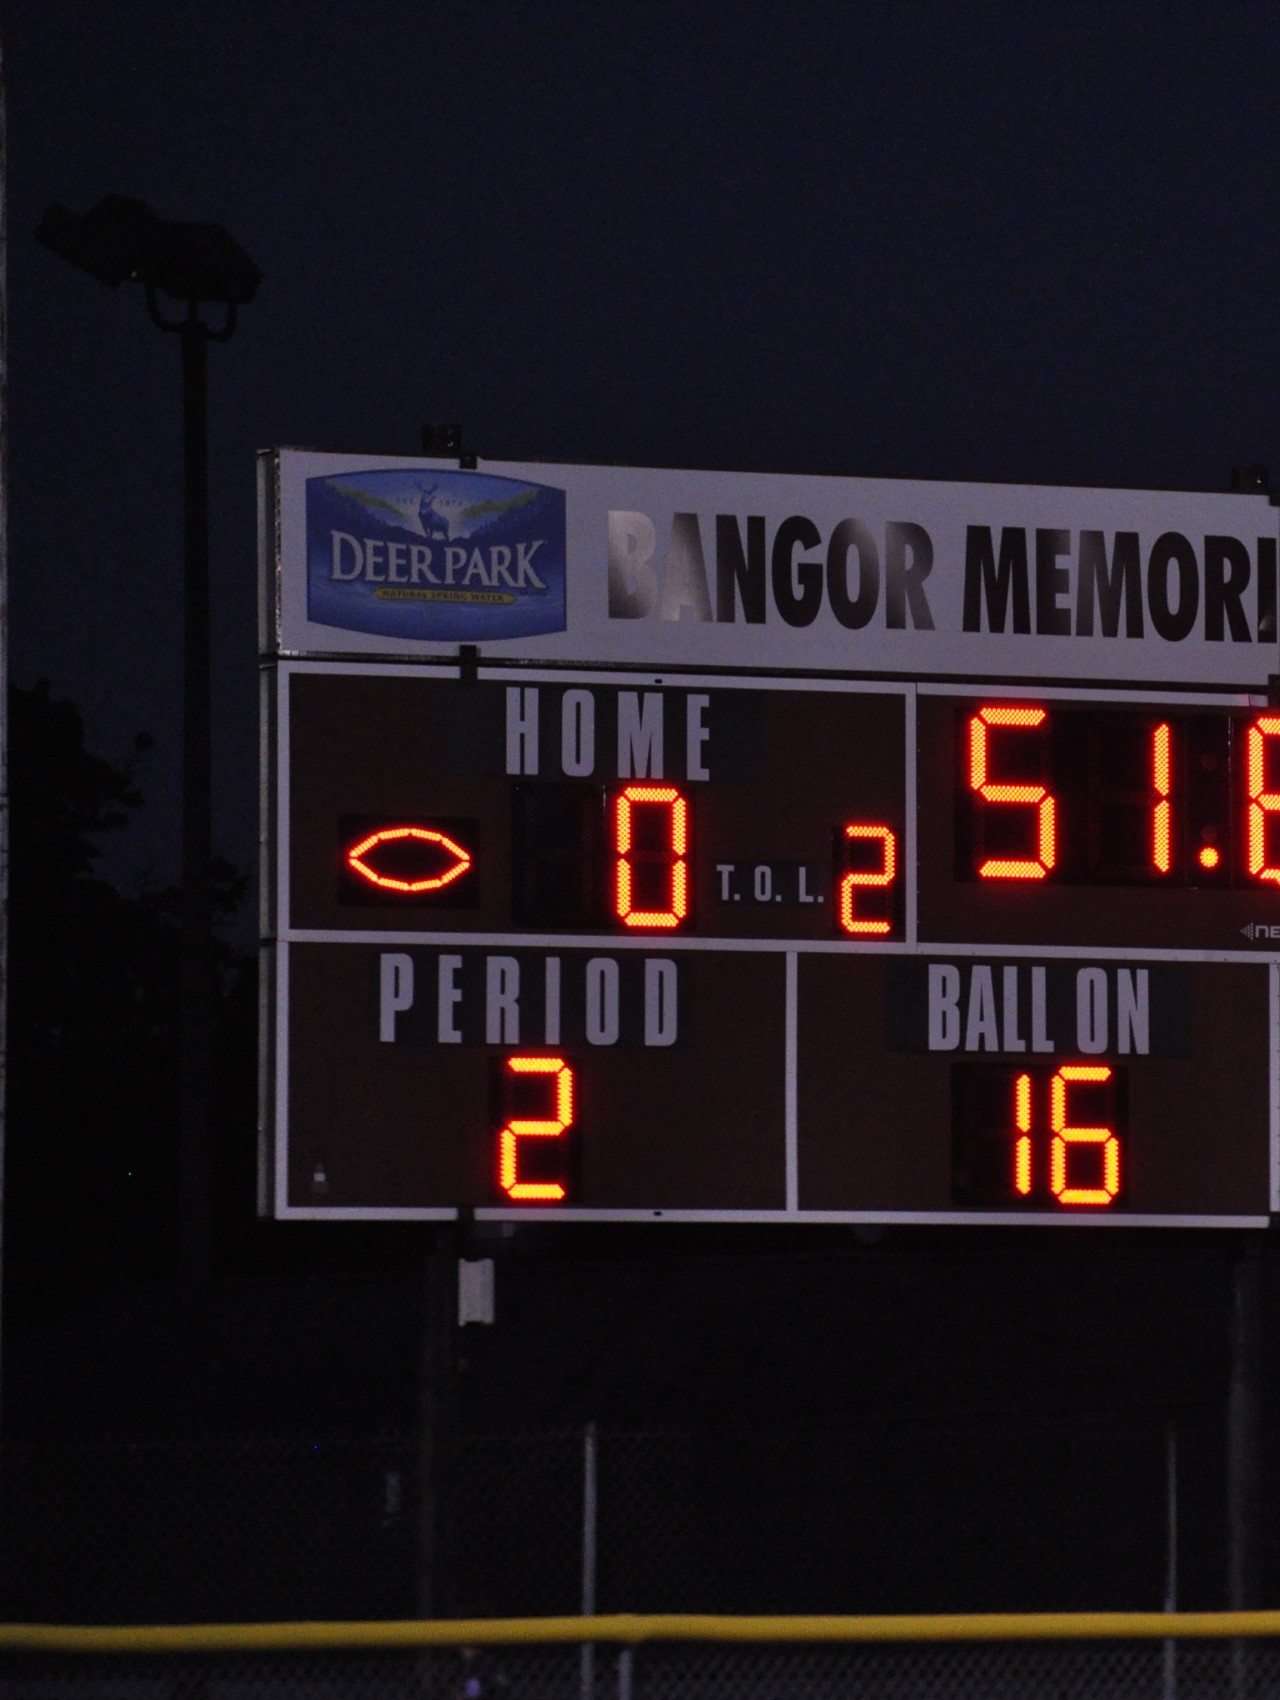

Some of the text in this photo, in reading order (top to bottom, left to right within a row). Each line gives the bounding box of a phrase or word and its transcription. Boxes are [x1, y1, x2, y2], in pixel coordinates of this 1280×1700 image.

[330, 529, 547, 589] DEER PARK
[607, 509, 936, 631] BANGOR
[505, 686, 711, 782] HOME
[614, 785, 690, 929] 0
[839, 824, 897, 935] 2
[378, 952, 678, 1048] PERIOD
[927, 963, 1151, 1055] BALL ON
[499, 1055, 574, 1202] 2
[1014, 1064, 1121, 1206] 16
